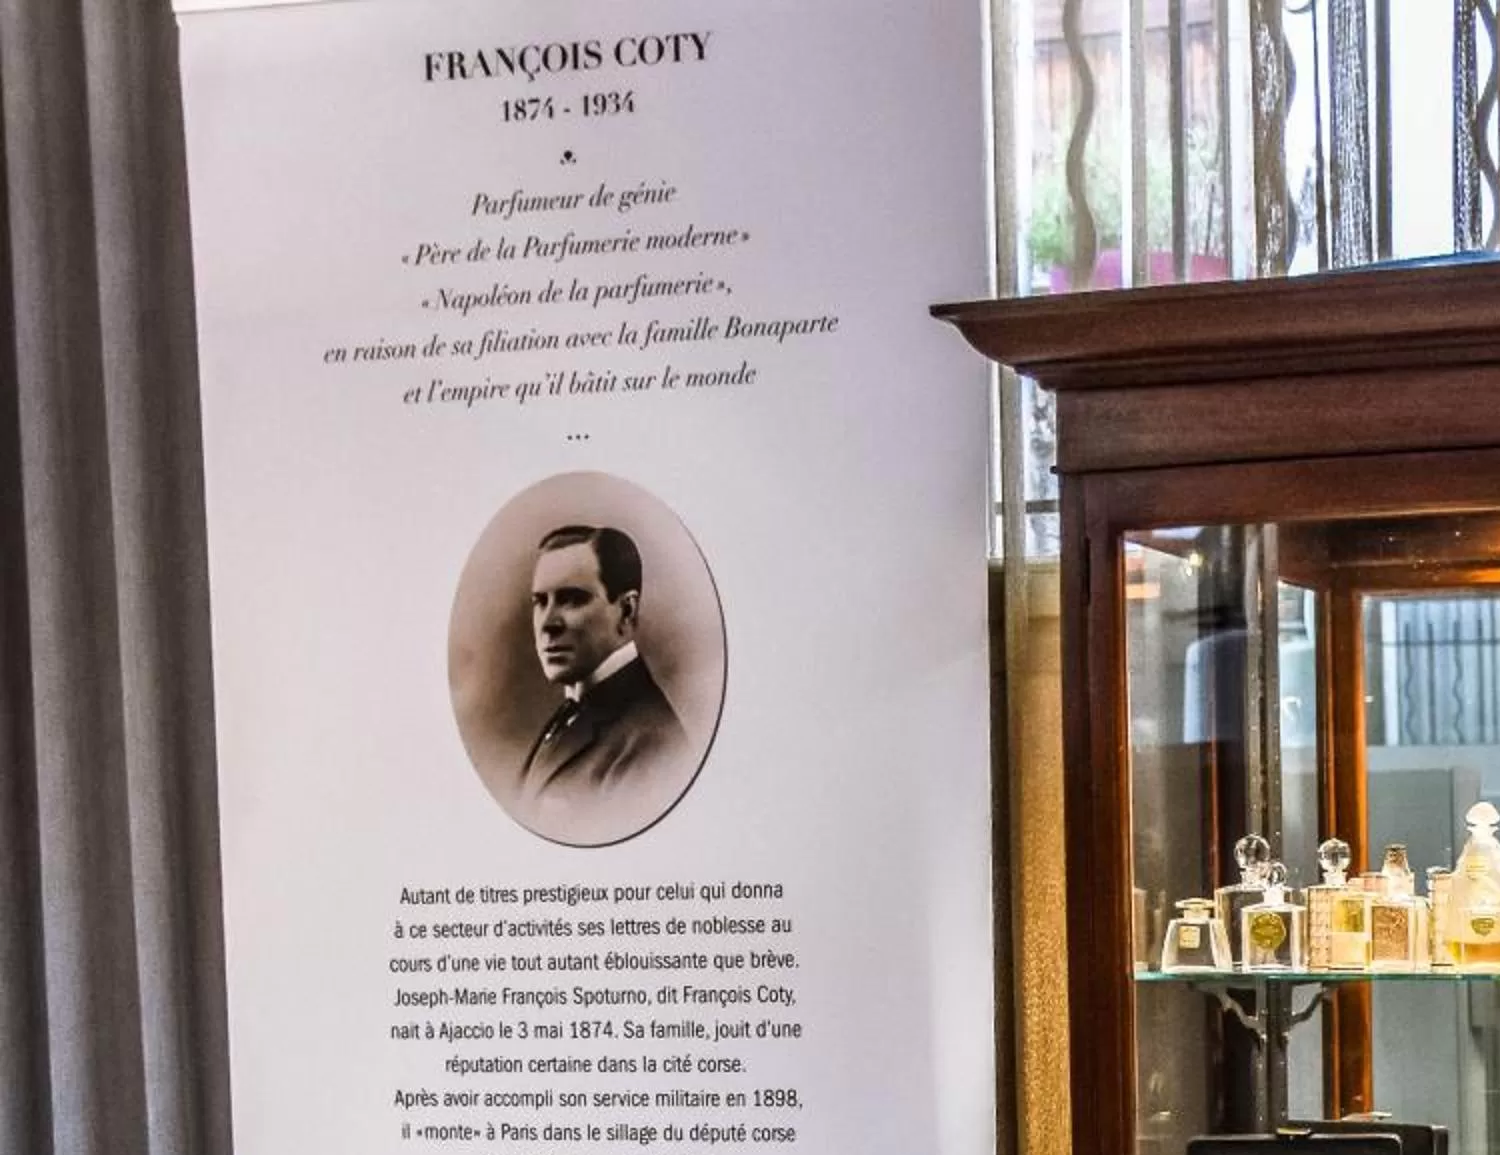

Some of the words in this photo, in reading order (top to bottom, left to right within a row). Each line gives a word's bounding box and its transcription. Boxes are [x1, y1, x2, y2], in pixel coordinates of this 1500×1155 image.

[424, 39, 604, 83] FRANÇOIS
[613, 31, 711, 67] COTY
[502, 95, 555, 123] 1874
[582, 89, 635, 117] 1934
[471, 189, 585, 221] Parfumeur
[588, 183, 615, 208] de
[617, 179, 677, 214] génie
[466, 238, 492, 263] de
[495, 235, 517, 261] la
[522, 228, 641, 264] Parfumerie
[537, 279, 564, 305] de
[568, 277, 589, 302] la
[323, 347, 348, 364] en
[353, 338, 417, 362] raison
[421, 333, 447, 358] de
[450, 339, 473, 356] sa
[473, 328, 560, 361] filiation
[564, 331, 613, 350] avec
[617, 321, 639, 346] la
[639, 315, 720, 351] famille
[723, 315, 839, 344] Bonaparte
[403, 386, 422, 405] et
[426, 377, 511, 409] l'empire
[568, 369, 618, 395] bâtit
[621, 375, 657, 393] sur
[660, 364, 681, 390] le
[685, 359, 757, 388] monde
[399, 886, 453, 906] Autant
[454, 885, 476, 906] de
[478, 885, 520, 905] titres
[522, 883, 609, 908] prestigieux
[612, 885, 653, 905] pour
[655, 881, 696, 902] celui
[698, 880, 727, 905] qui
[730, 880, 784, 900] donna
[393, 919, 405, 940] à
[408, 923, 428, 940] ce
[431, 921, 491, 940] secteur
[492, 916, 574, 941] d'activités
[576, 920, 606, 938] ses
[609, 916, 662, 937] lettres
[664, 916, 687, 937] de
[690, 914, 767, 936] noblesse
[770, 917, 793, 934] au
[388, 957, 434, 974] cours
[436, 953, 481, 973] d'une
[483, 952, 508, 972] vie
[510, 953, 544, 972] tout
[546, 952, 601, 972] autant
[603, 950, 709, 972] éblouissante
[712, 953, 745, 973] que
[749, 948, 800, 970] brève.
[393, 987, 497, 1010] Joseph-Marie
[501, 986, 569, 1010] François
[572, 985, 653, 1009] Spoturno,
[655, 985, 679, 1006] dit
[682, 984, 753, 1009] François
[756, 983, 797, 1008] Coty,
[424, 1020, 436, 1041] à
[438, 1020, 495, 1044] Ajaccio
[498, 1020, 514, 1040] le
[516, 1020, 529, 1040] 3
[532, 1020, 564, 1040] mai
[569, 1019, 619, 1040] 1874.
[622, 1018, 646, 1040] Sa
[648, 1018, 712, 1041] famille,
[712, 1018, 753, 1043] jouit
[755, 1018, 803, 1039] d'une
